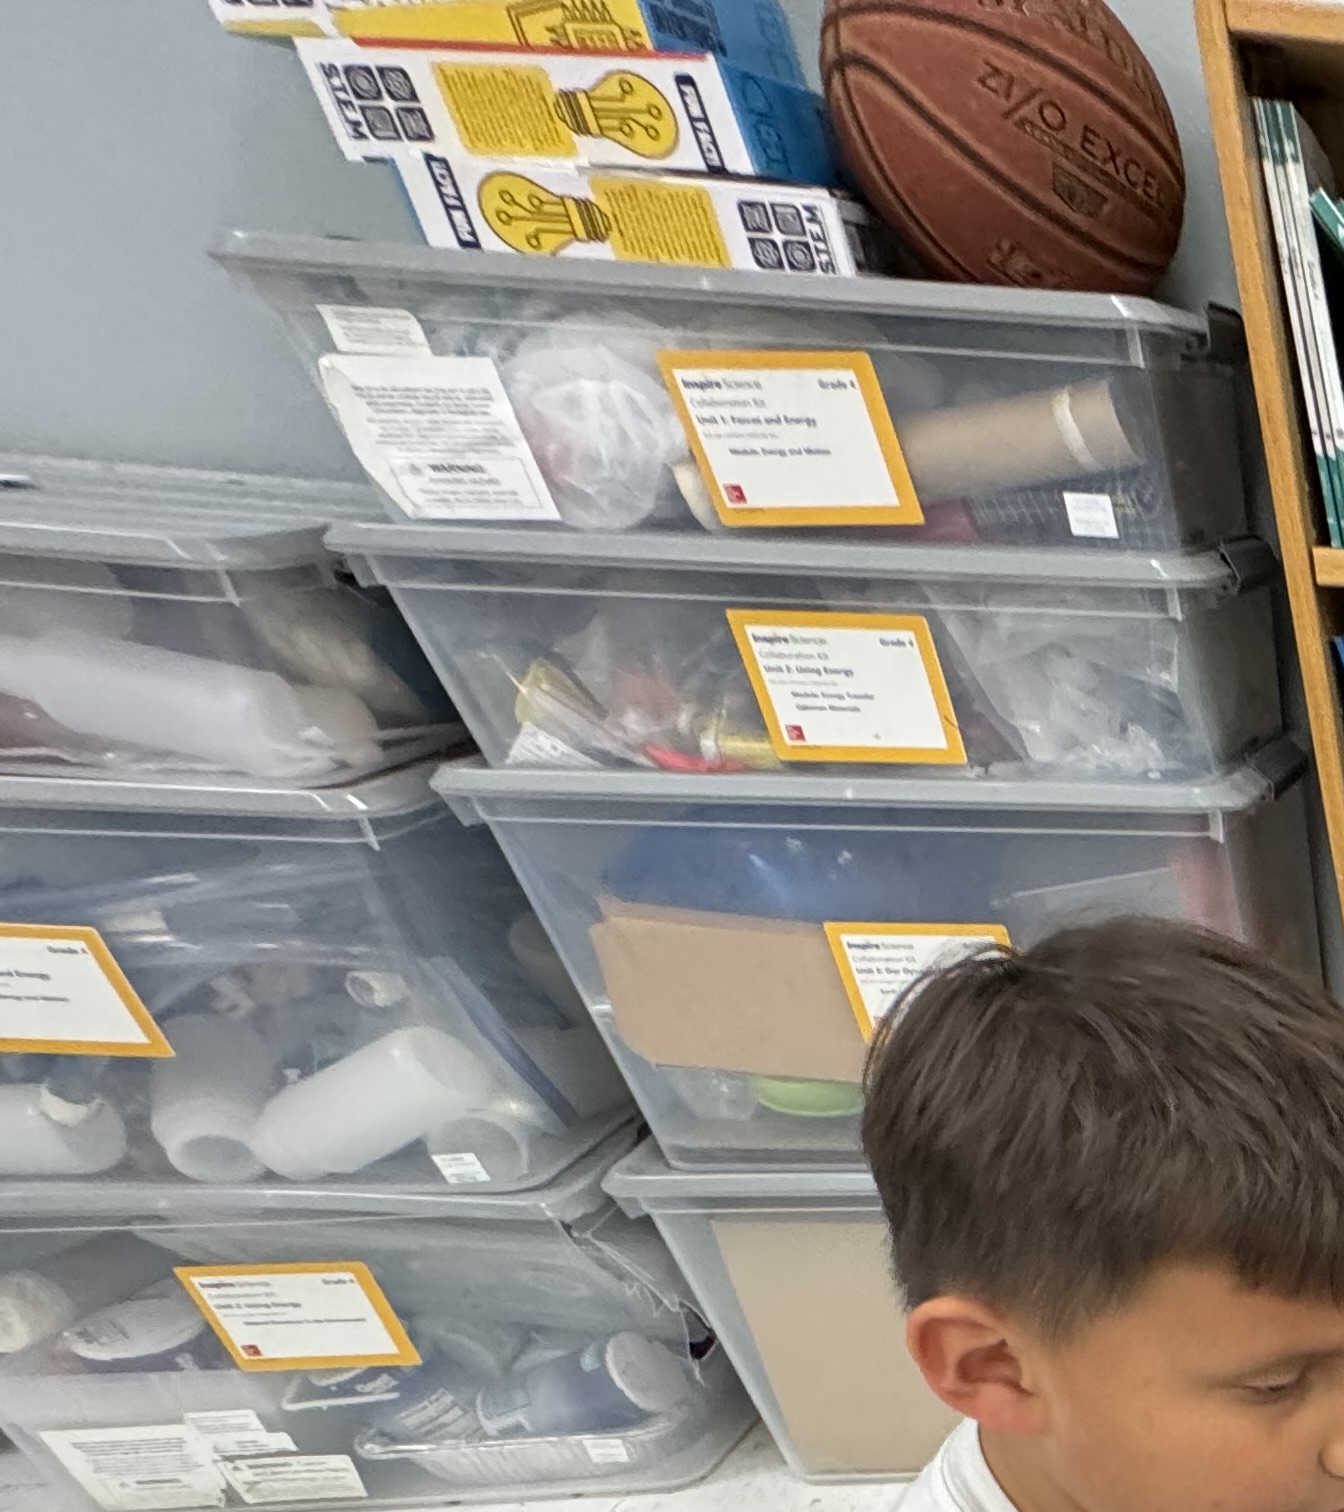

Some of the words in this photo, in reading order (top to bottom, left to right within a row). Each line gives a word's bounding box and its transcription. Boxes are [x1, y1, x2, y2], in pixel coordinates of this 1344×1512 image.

[319, 61, 369, 141] STEM
[800, 202, 837, 275] STEM
[681, 377, 722, 392] Inspire
[751, 631, 789, 646] Inspire
[846, 940, 880, 951] Inspire
